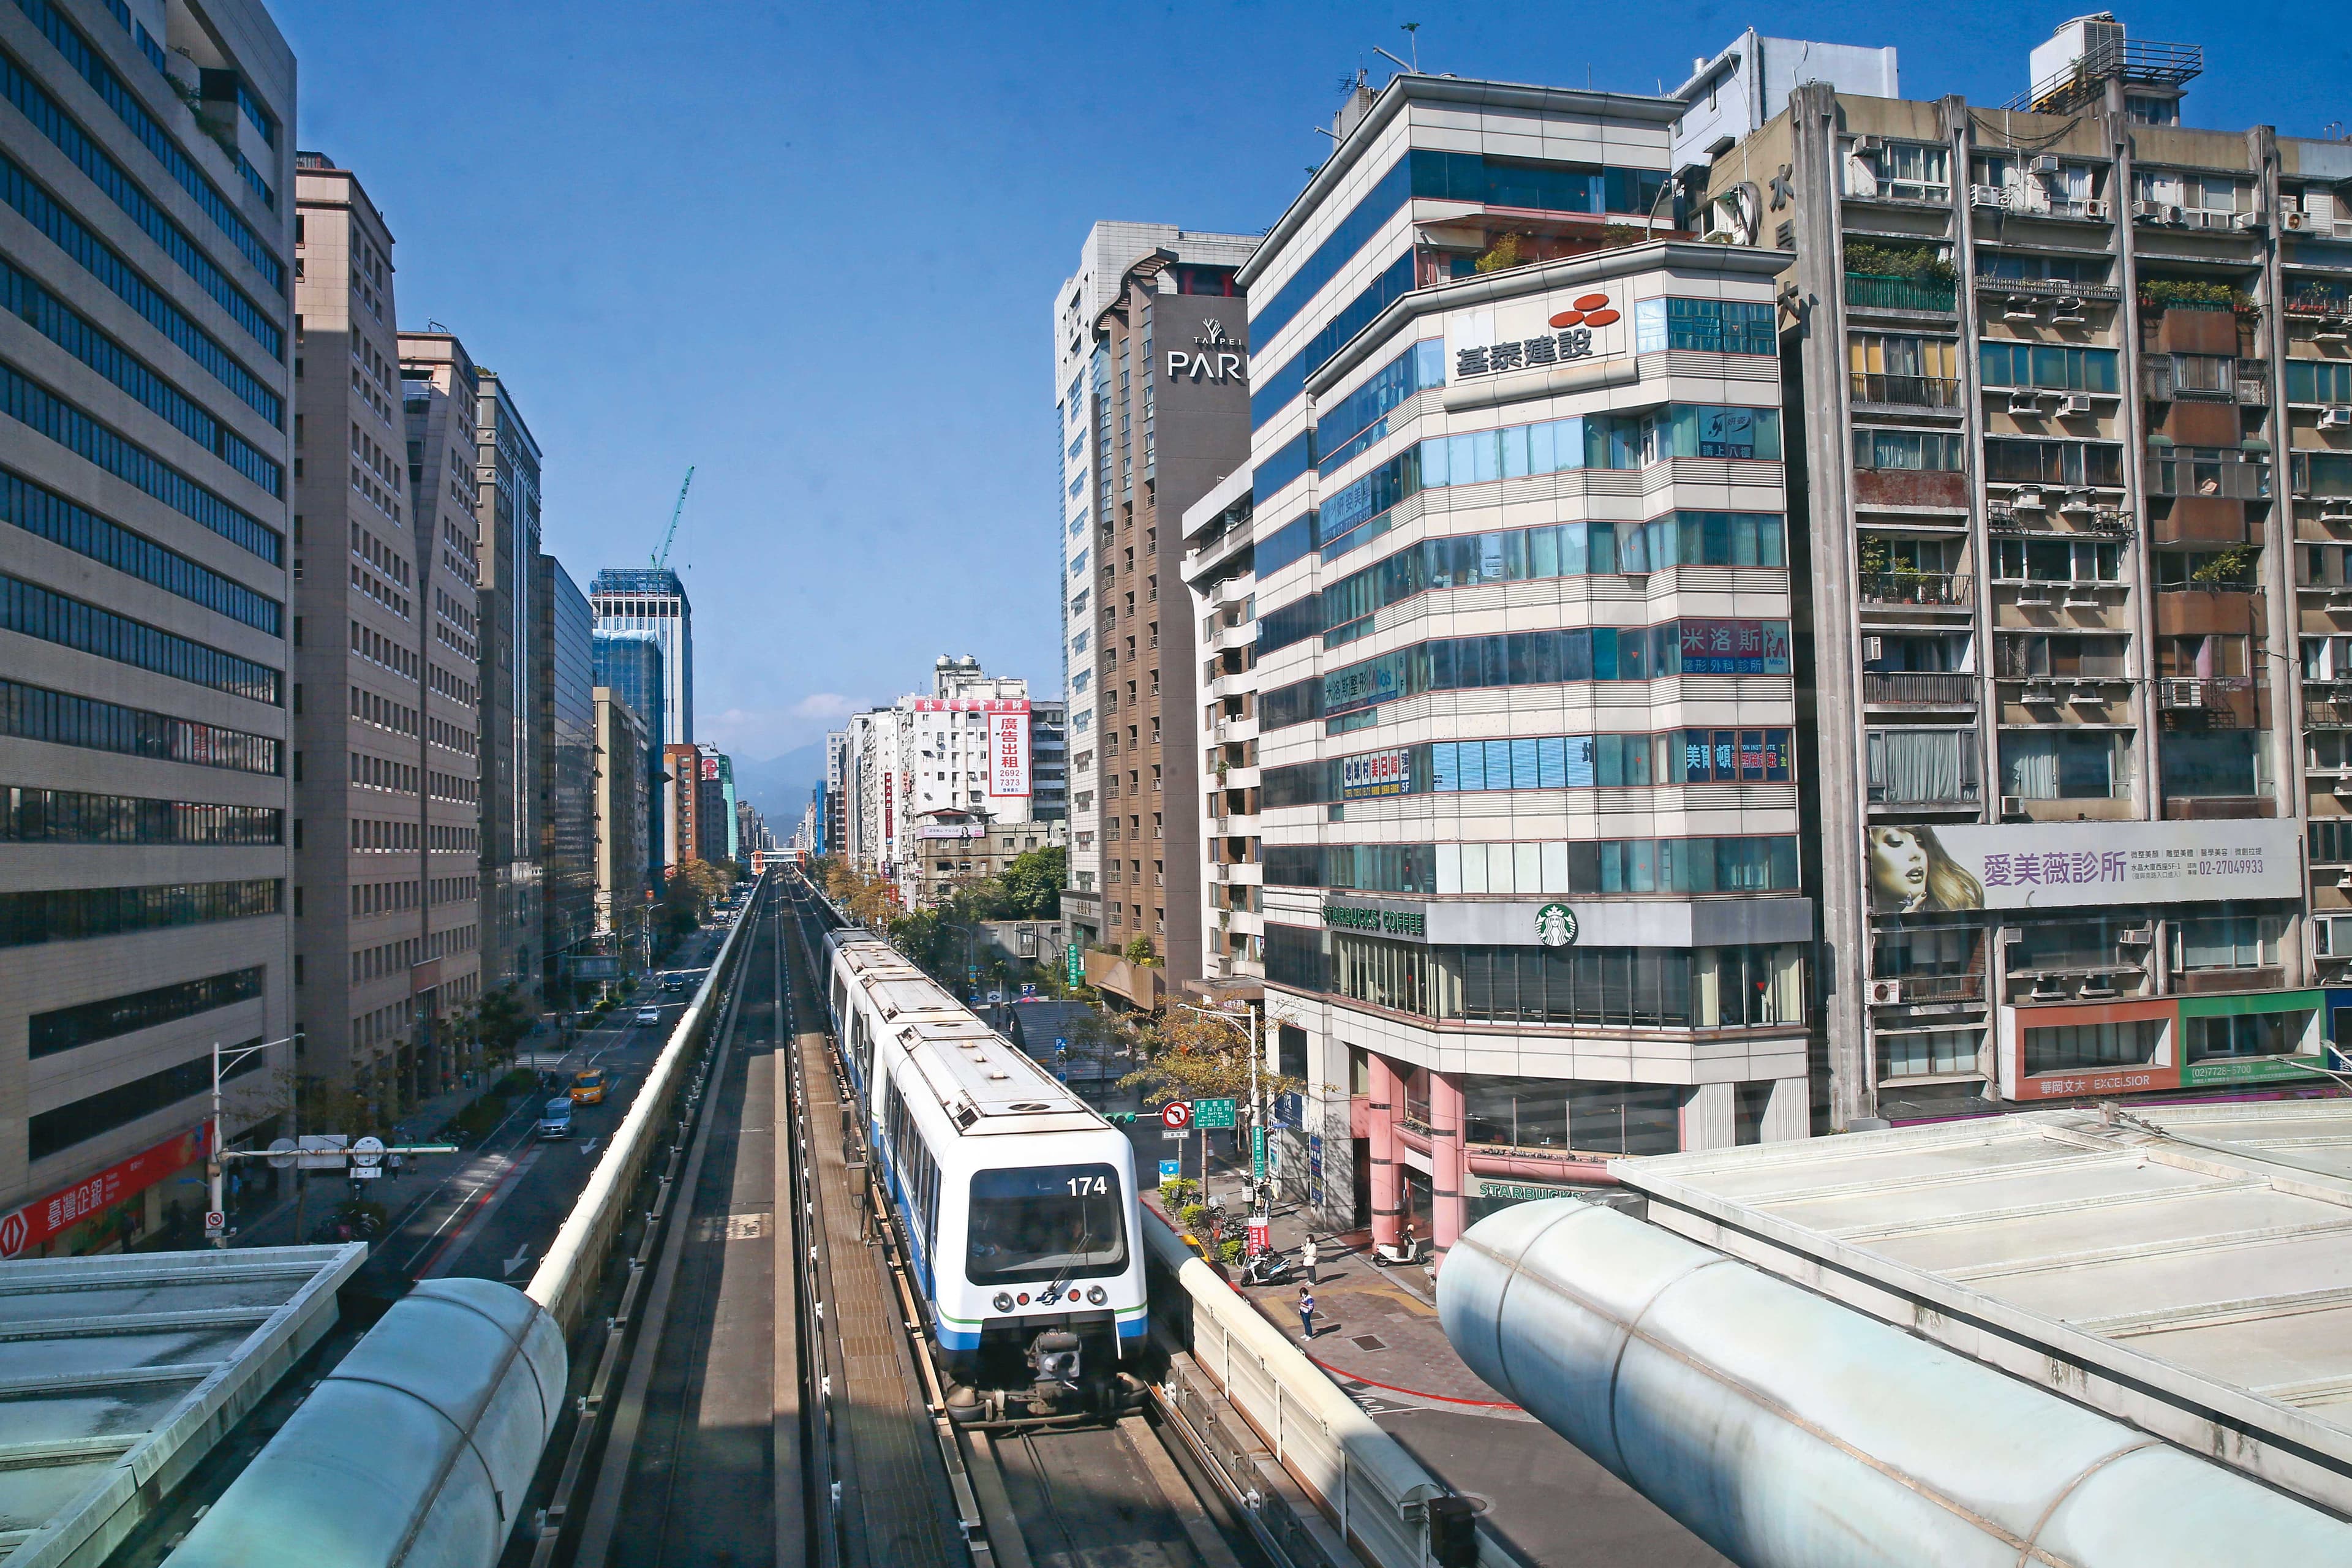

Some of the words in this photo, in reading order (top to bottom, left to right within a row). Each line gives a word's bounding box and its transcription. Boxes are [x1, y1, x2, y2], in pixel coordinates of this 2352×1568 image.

[1167, 350, 1250, 379] PAR
[1456, 328, 1593, 377] 基泰建設
[1703, 445, 1751, 458] 請上八樓
[1682, 627, 1760, 651] 米洛斯
[1683, 659, 1762, 672] 整形外科診所
[1325, 671, 1367, 703] 米洛斯整形
[924, 700, 1023, 710] 林慶隆會計師
[1000, 718, 1019, 768] 廣告出租
[1401, 782, 1409, 793] 5F
[1985, 851, 2127, 888] 愛美薇診所
[2199, 859, 2263, 875] 02-27049933
[1323, 905, 1378, 928] STARBUCKS
[1383, 910, 1422, 933] COFFEE
[2040, 1080, 2086, 1095] 華岡文大
[2094, 1075, 2150, 1090] EXCELSIOR
[1067, 1176, 1107, 1197] 174
[47, 1178, 104, 1231] 臺灣企銀
